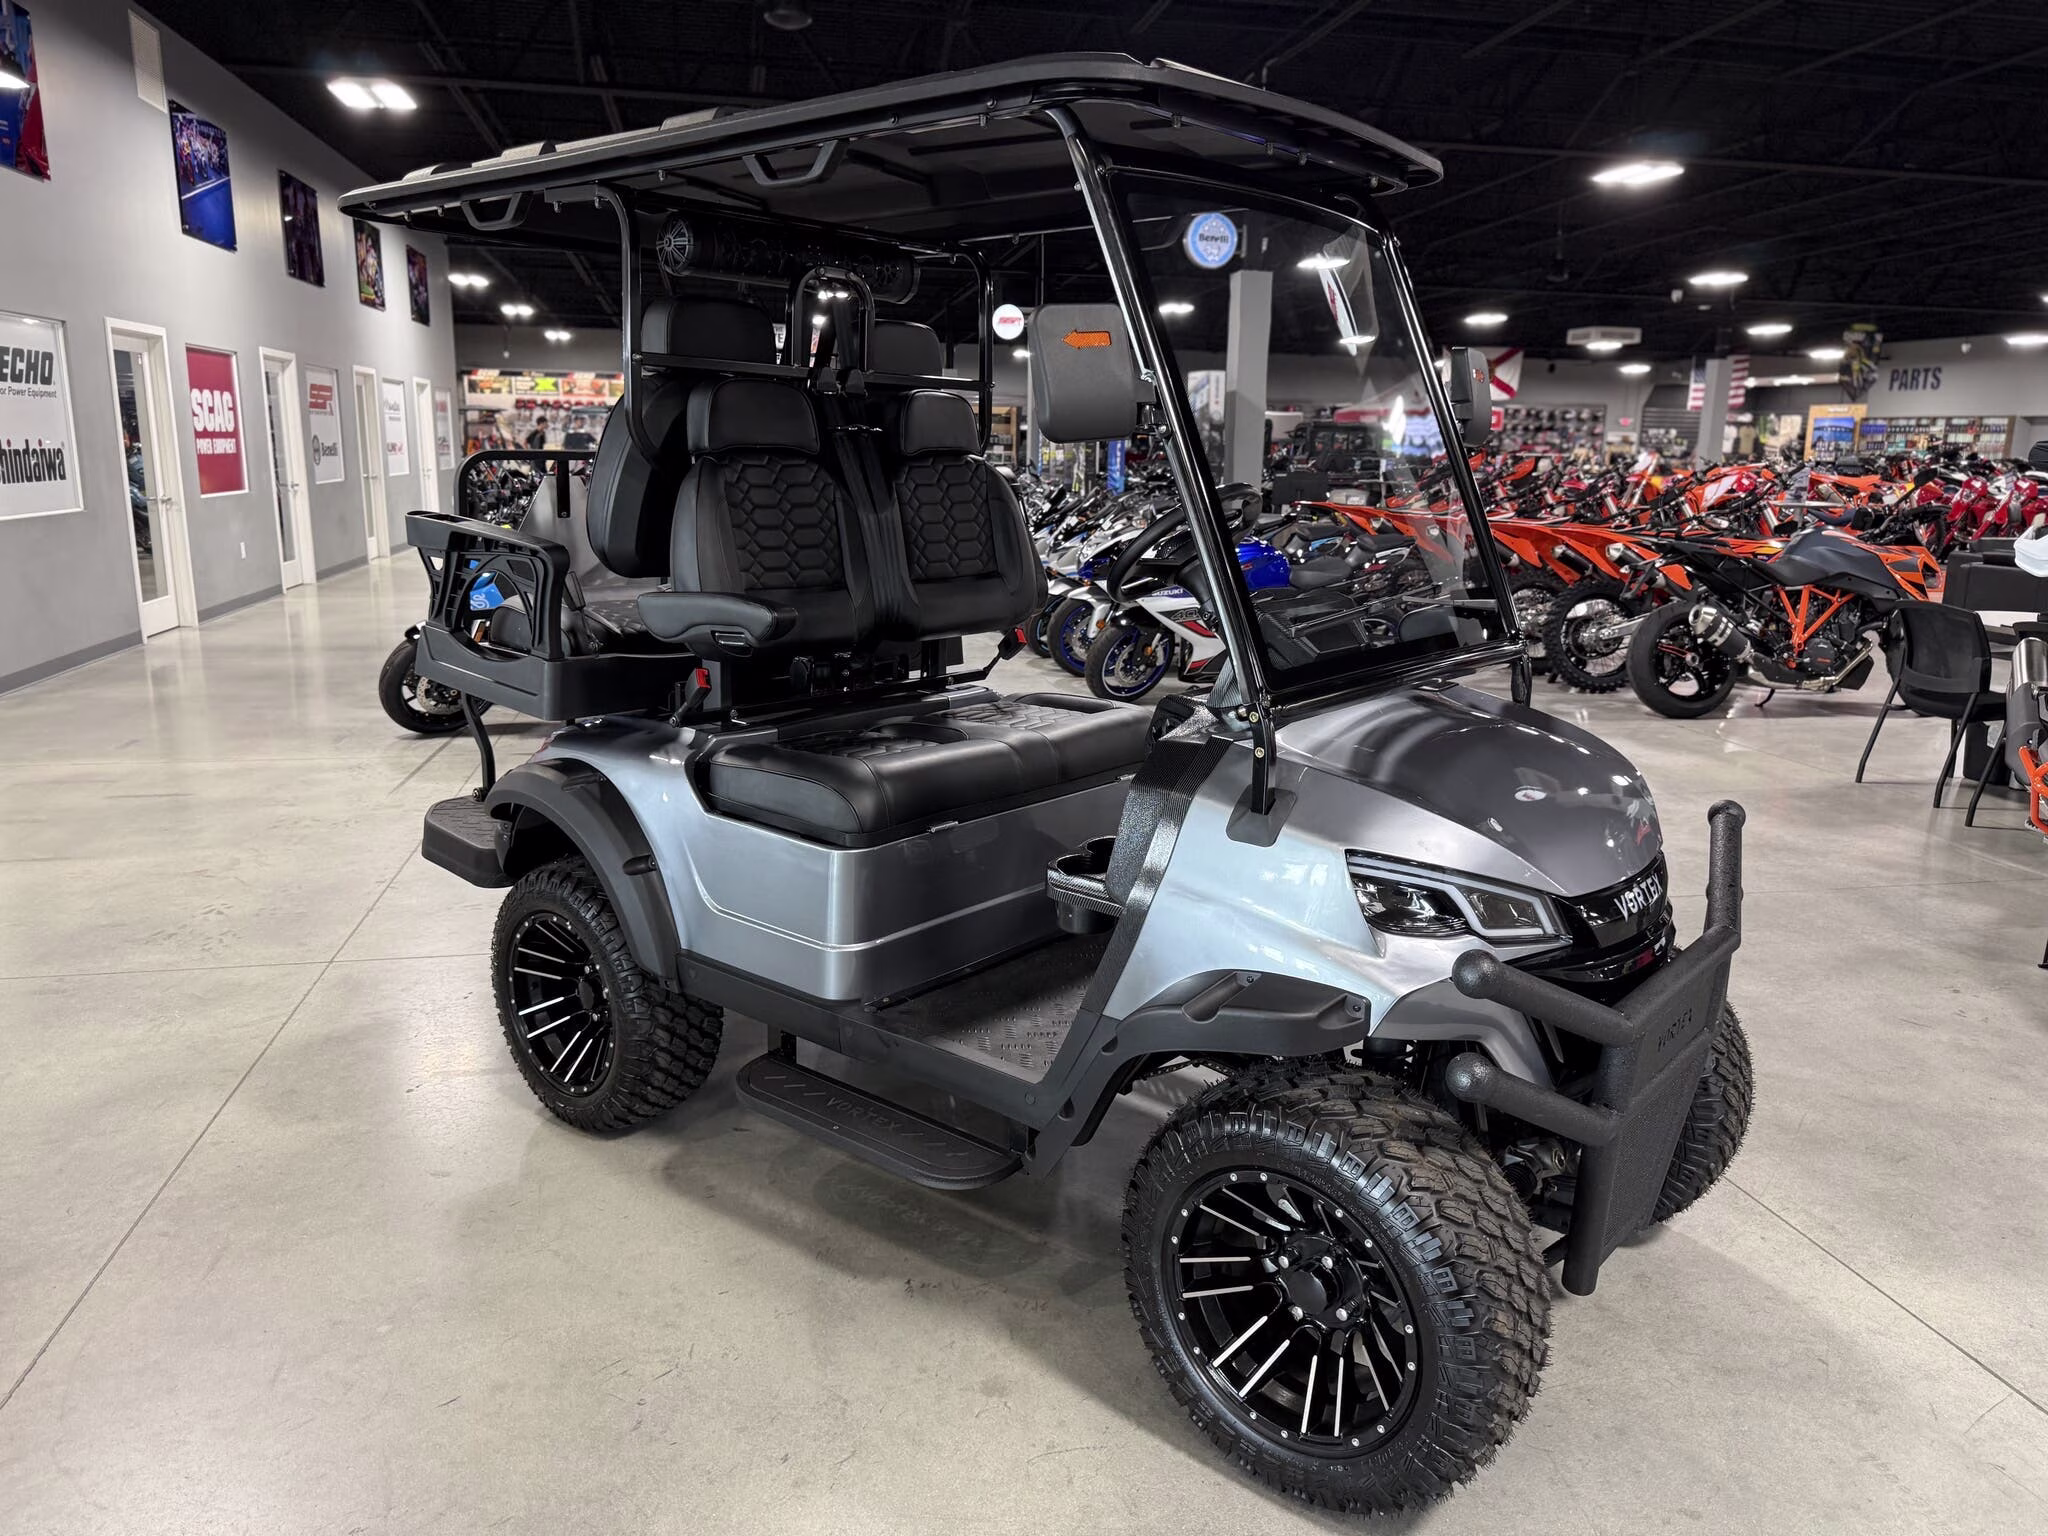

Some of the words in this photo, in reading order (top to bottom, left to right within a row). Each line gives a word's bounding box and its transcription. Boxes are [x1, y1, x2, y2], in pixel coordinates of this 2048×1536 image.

[0, 346, 54, 386] ECHO
[1888, 366, 1942, 392] PARTS
[8, 386, 27, 397] Power
[27, 387, 57, 399] Equipment
[191, 388, 235, 432] SCAG
[0, 438, 66, 484] hindaiwa
[1614, 872, 1663, 923] VORTEX
[826, 1096, 903, 1132] VORTEX
